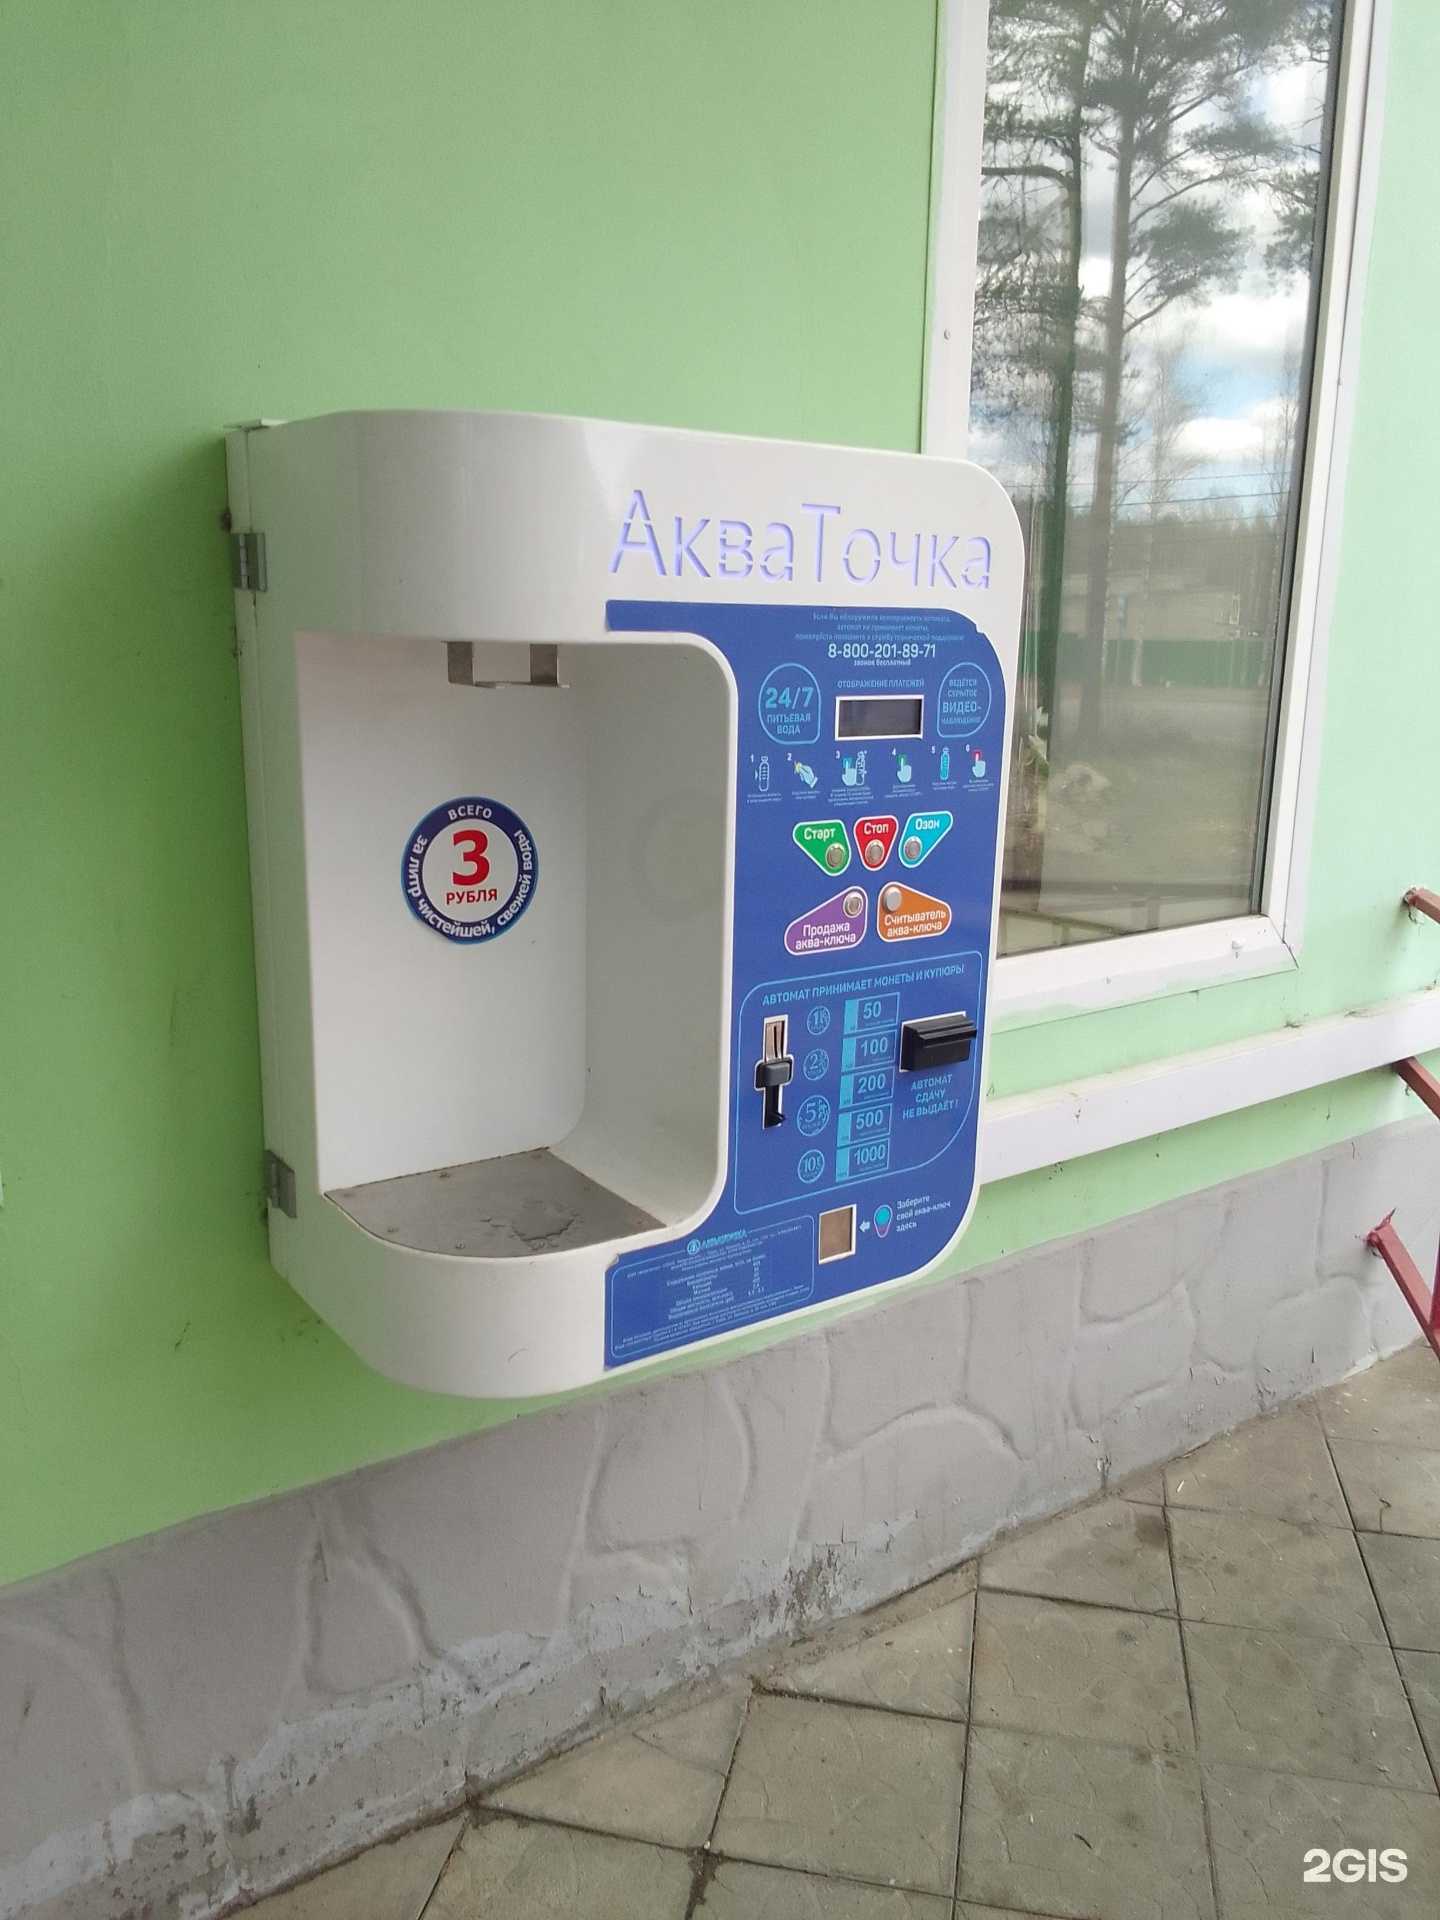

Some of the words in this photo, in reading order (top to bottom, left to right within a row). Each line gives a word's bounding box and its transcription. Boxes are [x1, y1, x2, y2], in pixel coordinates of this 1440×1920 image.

[607, 489, 992, 589] АкваТочка
[827, 643, 937, 659] 8-800-201-89-71
[765, 687, 814, 710] 24/7
[767, 713, 811, 724] ПИТЬЕВАЯ
[776, 725, 801, 736] ВОДА
[447, 804, 493, 820] ВСЕГО
[863, 822, 889, 835] Стоп
[915, 817, 941, 831] Озон
[803, 827, 837, 841] Старт
[412, 834, 428, 855] за
[514, 829, 533, 871] воды
[451, 829, 491, 886] 3
[408, 856, 422, 898] литр
[446, 888, 499, 905] РУБЛЯ
[496, 874, 532, 926] свежей
[418, 900, 496, 938] чистейшей,
[884, 909, 947, 926] Считыватель
[803, 921, 851, 939] Продажа
[886, 921, 943, 938] аква-ключа
[795, 932, 857, 950] аква-ключа
[761, 988, 812, 1007] АВТОМАТ
[812, 978, 873, 999] ПРИНИМАЕТ
[873, 973, 915, 989] МОНЕТЫ
[915, 970, 924, 981] И
[924, 963, 966, 980] КУПЮРЫ
[863, 1001, 882, 1019] 50
[861, 1037, 888, 1057] 100
[857, 1073, 887, 1094] 200
[911, 1074, 952, 1090] АВТОМАТ
[915, 1088, 946, 1103] СДАЧУ
[804, 1102, 816, 1122] 5
[855, 1109, 884, 1130] 500
[903, 1108, 915, 1120] НЕ
[854, 1144, 886, 1166] 1000
